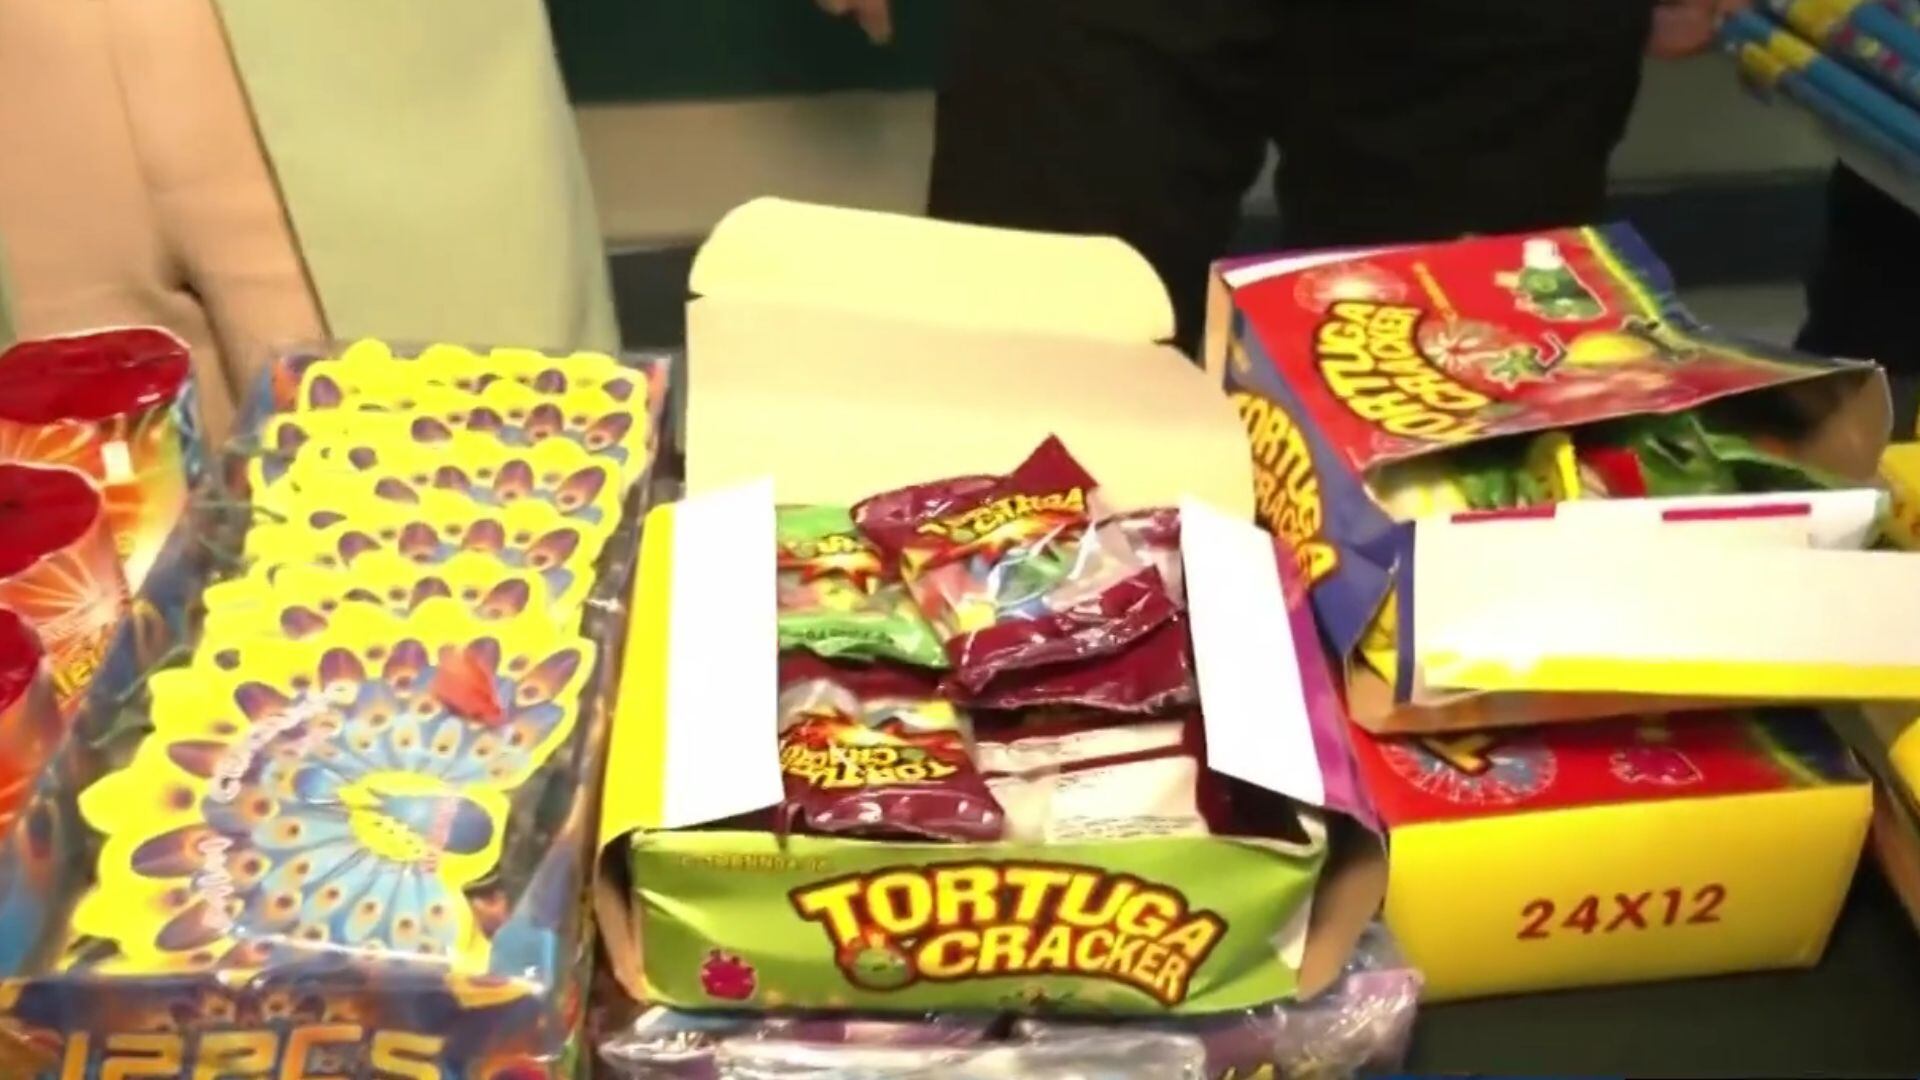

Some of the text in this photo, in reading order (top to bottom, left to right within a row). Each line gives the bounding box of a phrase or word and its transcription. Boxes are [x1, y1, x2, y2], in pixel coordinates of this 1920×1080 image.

[1318, 301, 1490, 441] TORTUGA
[1367, 306, 1490, 412] CRACKER
[800, 865, 1221, 957] TORTUGA
[1516, 884, 1727, 940] 24X12
[917, 924, 1190, 1003] CRACKER
[60, 1025, 445, 1080] 12PCS
